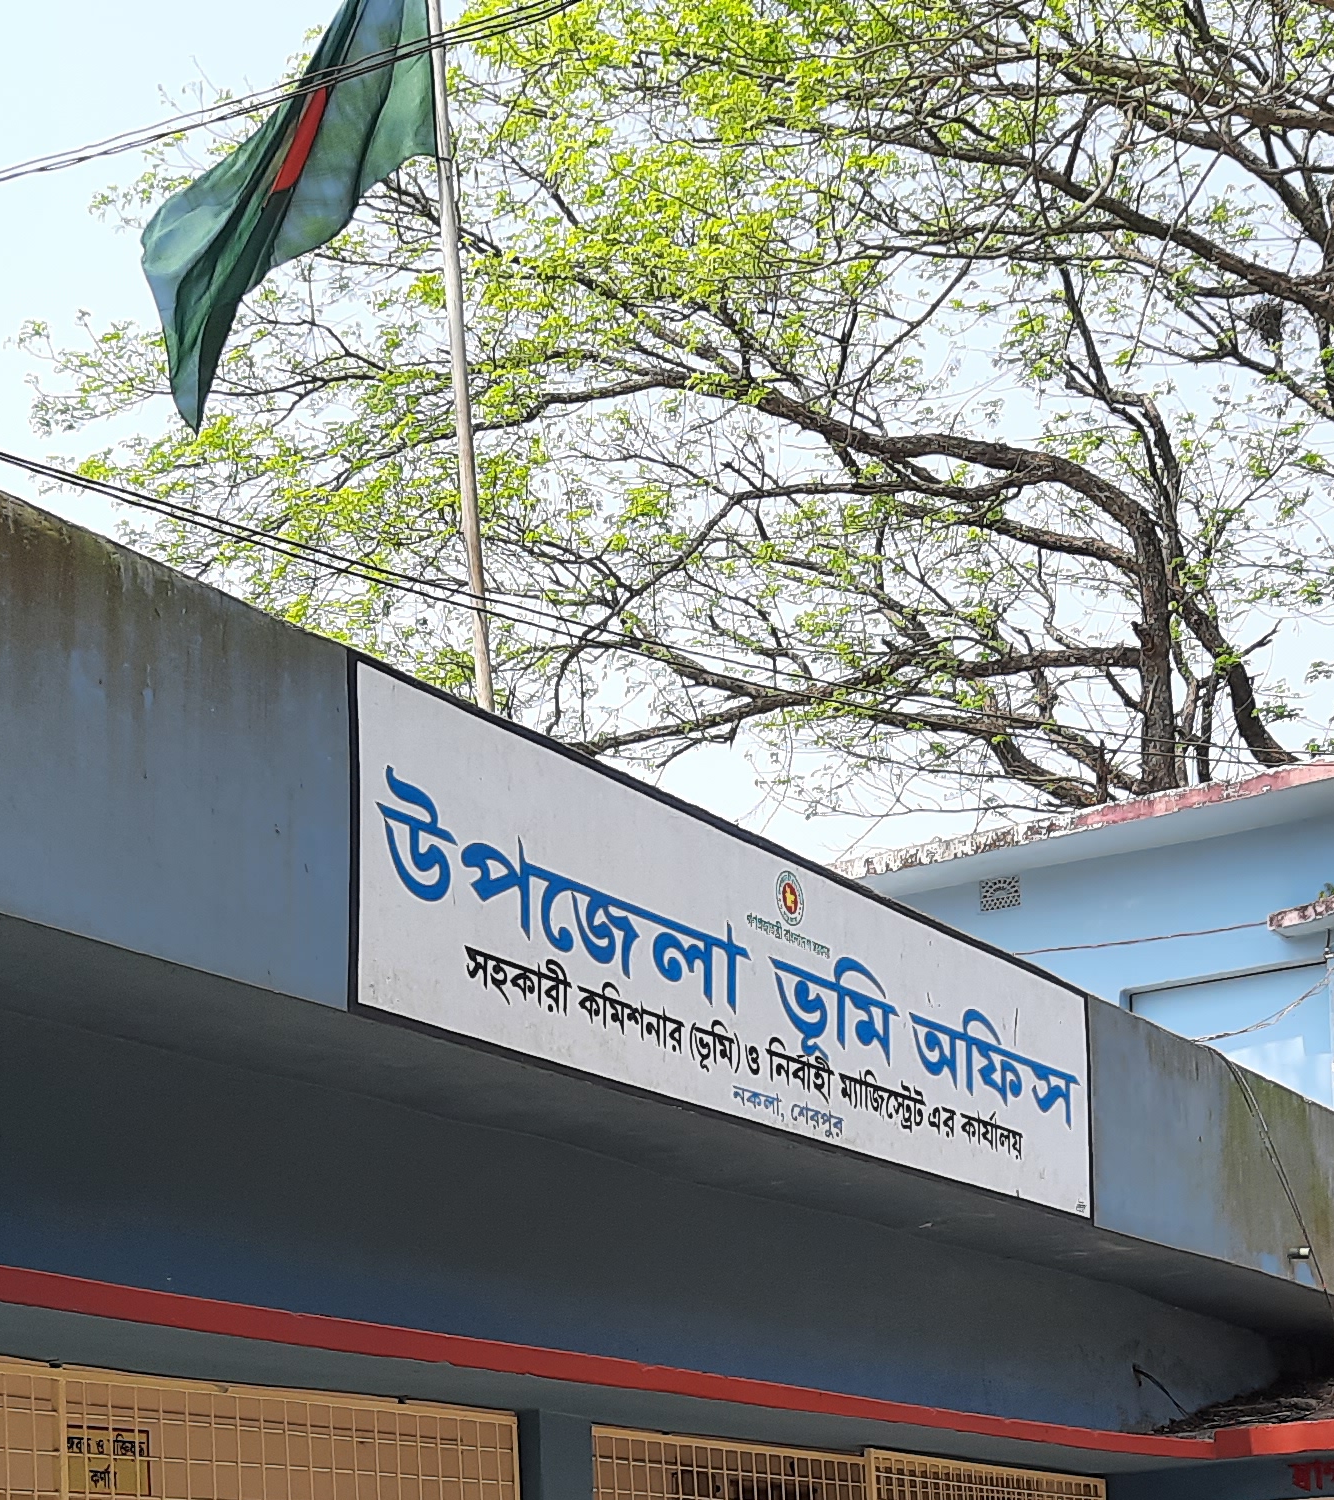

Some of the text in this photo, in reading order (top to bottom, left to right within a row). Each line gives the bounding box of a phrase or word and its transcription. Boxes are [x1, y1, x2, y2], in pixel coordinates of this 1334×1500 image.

[375, 765, 752, 1015] উপজেলা
[767, 956, 900, 1066] ভূমি
[909, 1009, 1080, 1129] অফিস
[464, 945, 1024, 1160] সহকারী কমিশনার (ভূমি) ও নির্বাহী ম্যাজিস্ট্রেট এর কার্যালয়
[732, 1085, 845, 1138] নকলা, শেরপুর
